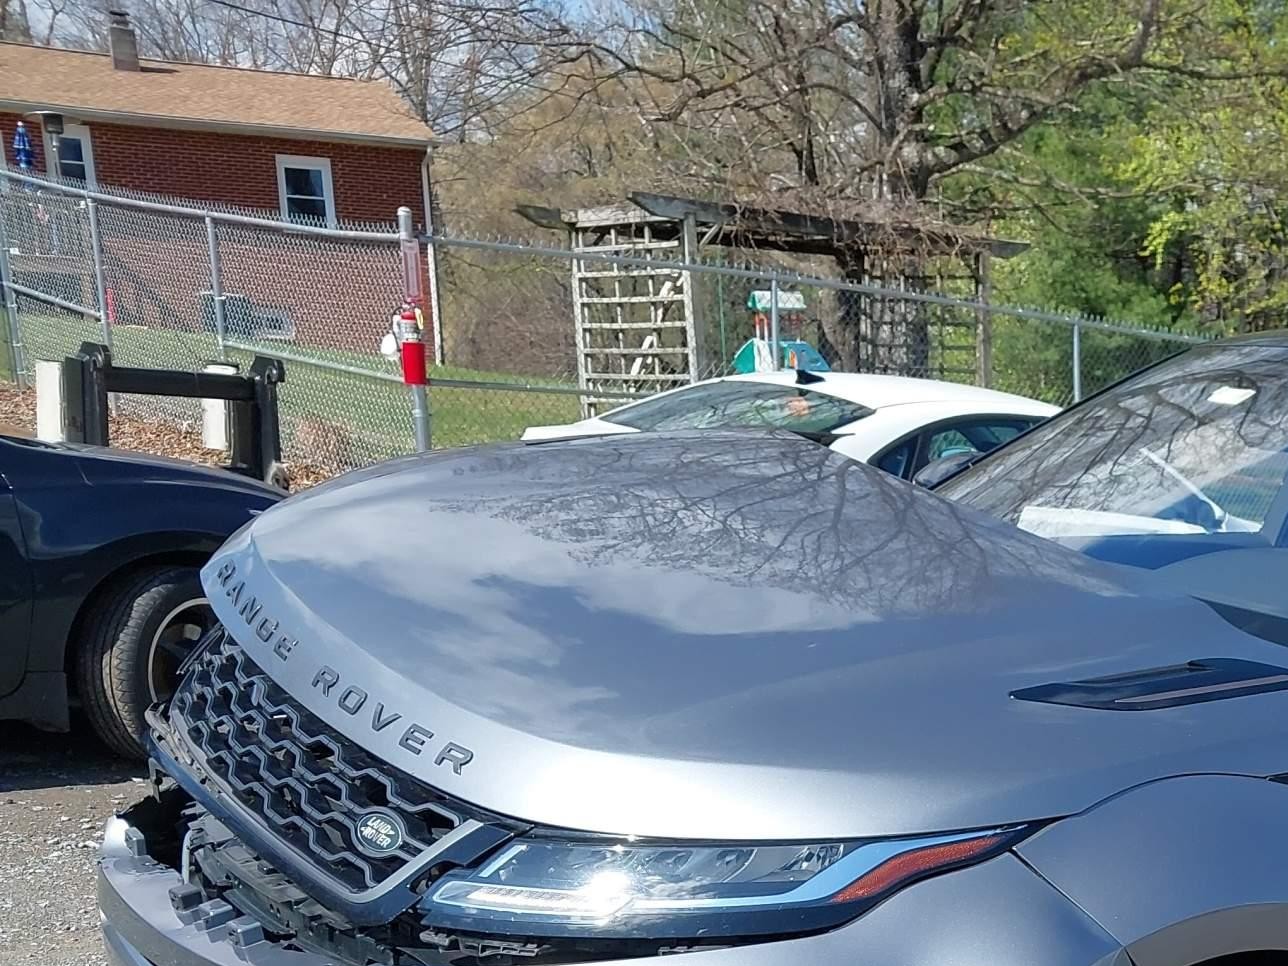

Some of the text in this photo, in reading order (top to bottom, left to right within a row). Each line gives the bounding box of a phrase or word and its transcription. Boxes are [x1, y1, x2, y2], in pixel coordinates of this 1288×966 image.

[216, 558, 475, 777] RANGE ROVER
[362, 825, 392, 848] ROVER
[366, 816, 391, 835] LAND
